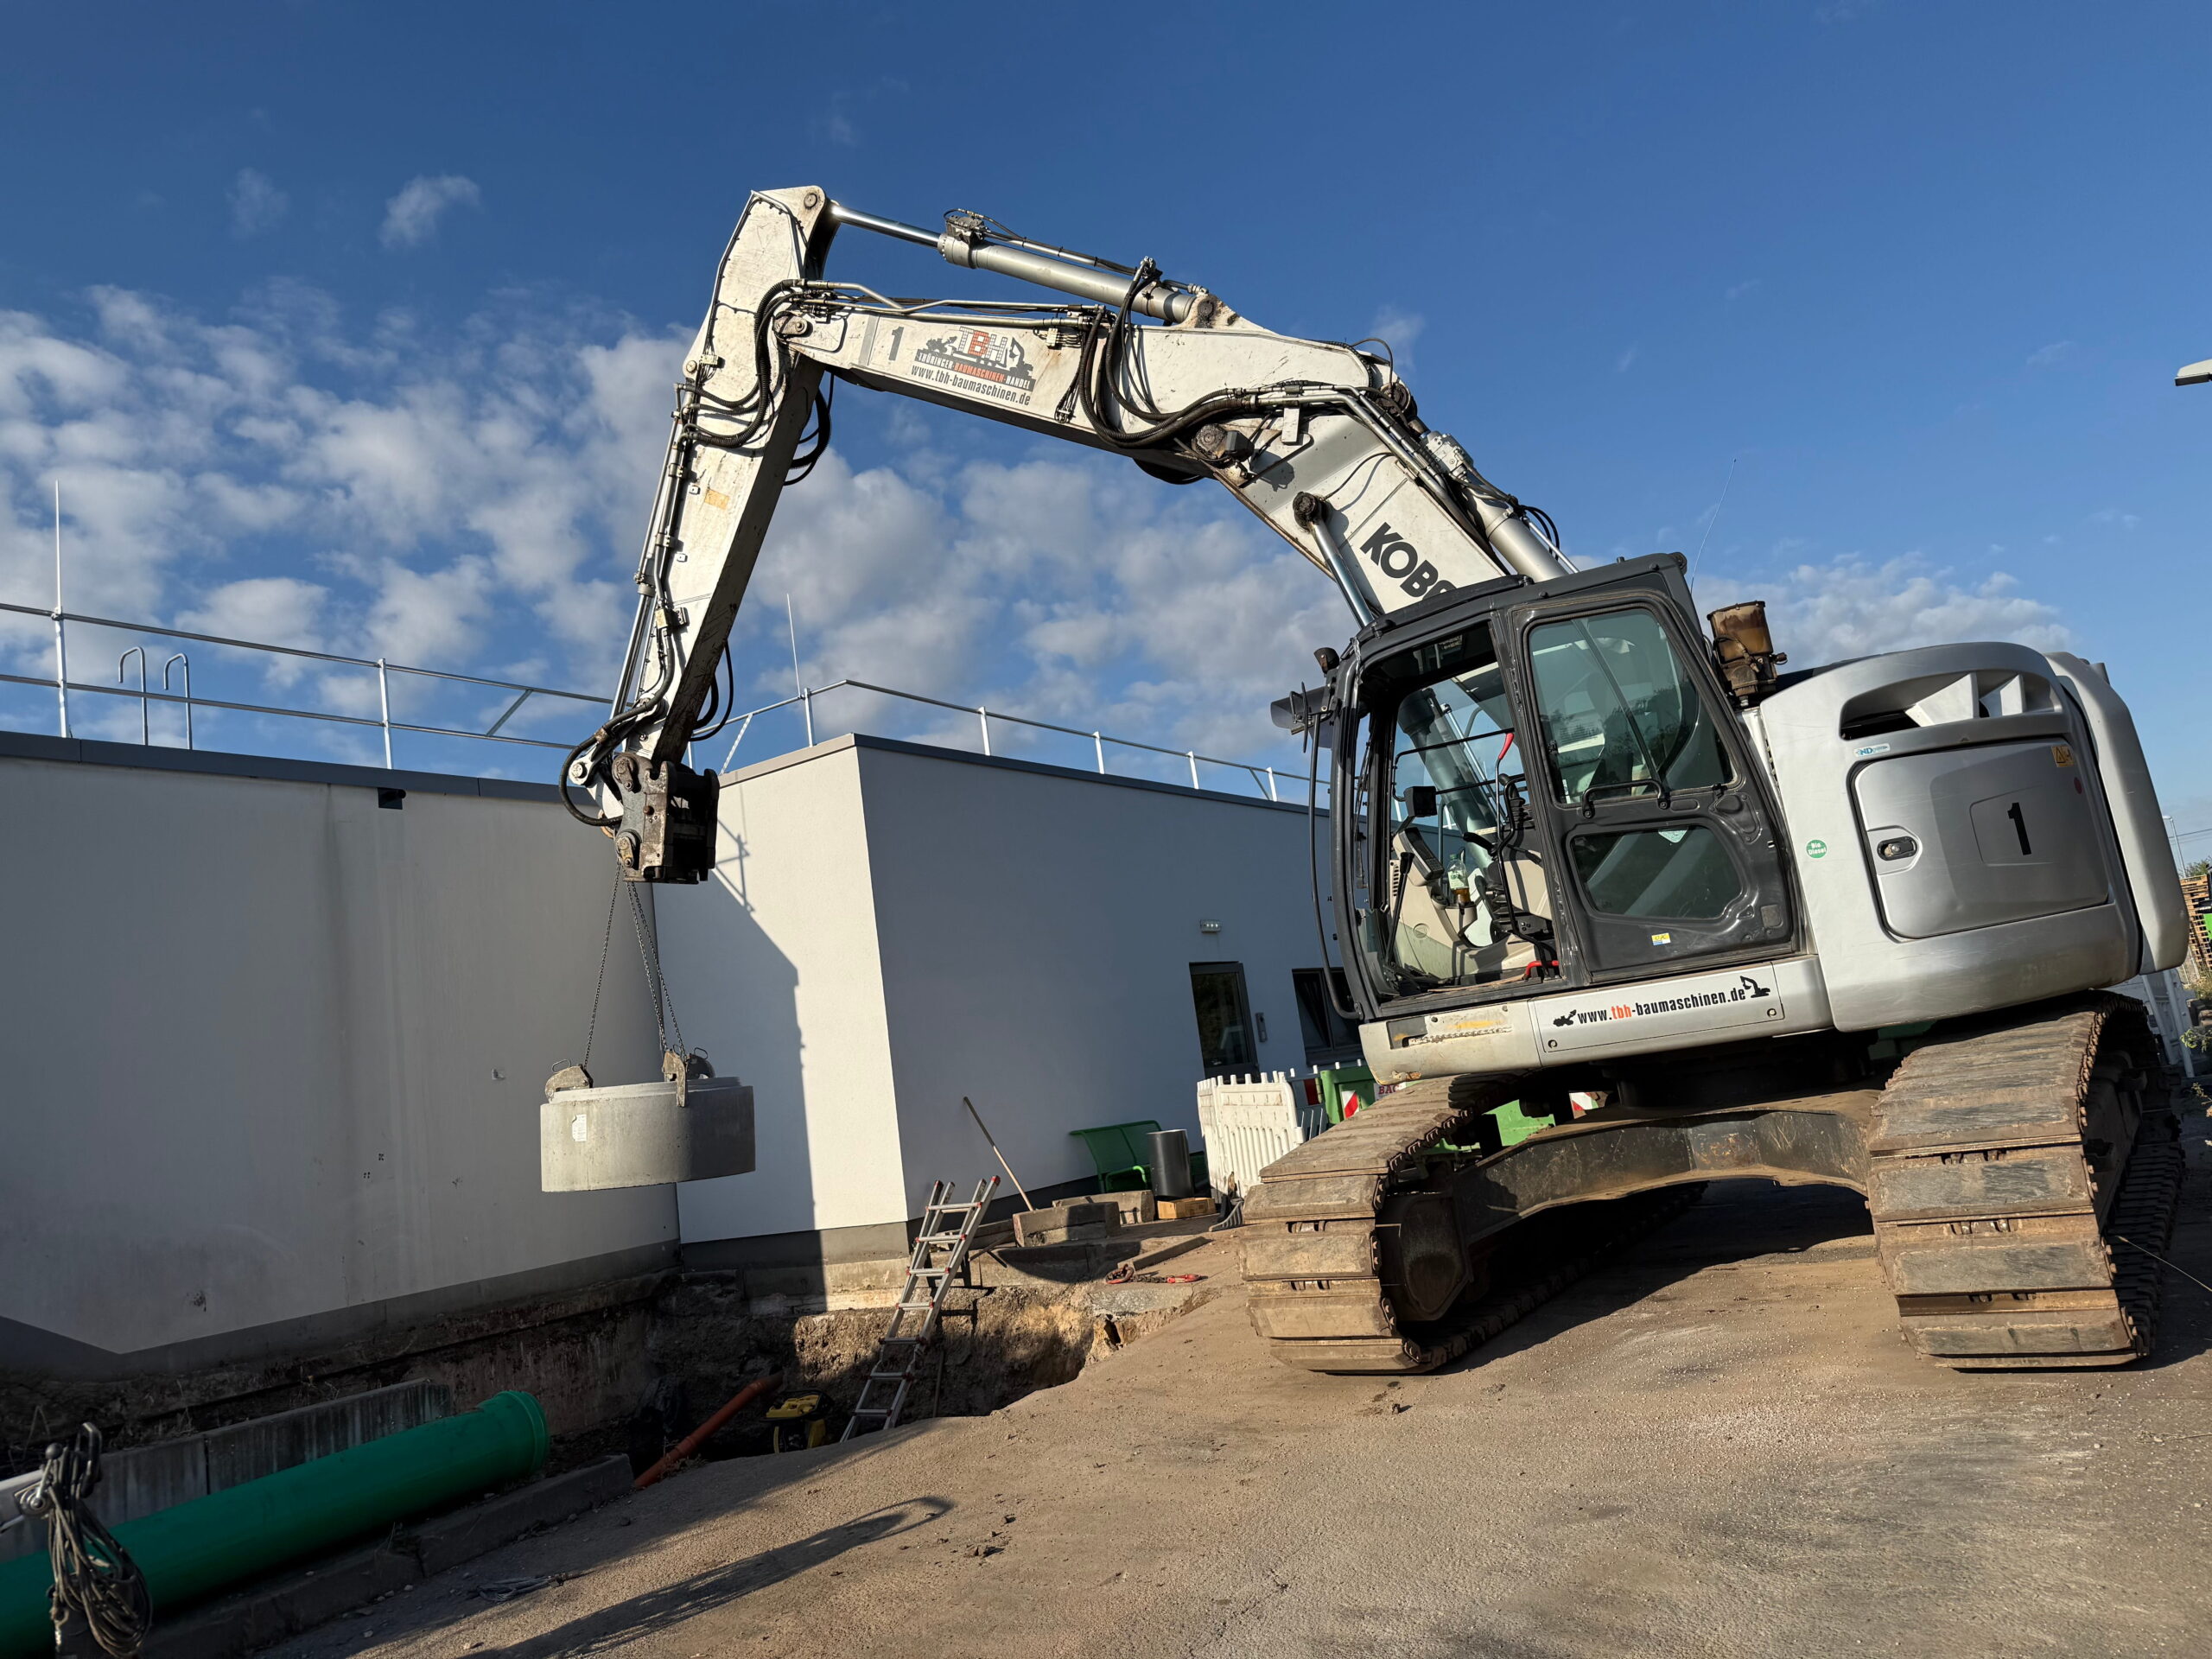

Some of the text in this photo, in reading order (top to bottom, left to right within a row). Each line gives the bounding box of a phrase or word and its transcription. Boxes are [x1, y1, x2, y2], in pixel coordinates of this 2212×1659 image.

[888, 327, 905, 361] 1
[958, 326, 1008, 361] TBH
[911, 365, 1031, 406] www.tbh-baumaschinen.de
[2007, 802, 2032, 855] 1
[1577, 988, 1746, 1024] www.tbh-baumaschinen.de
